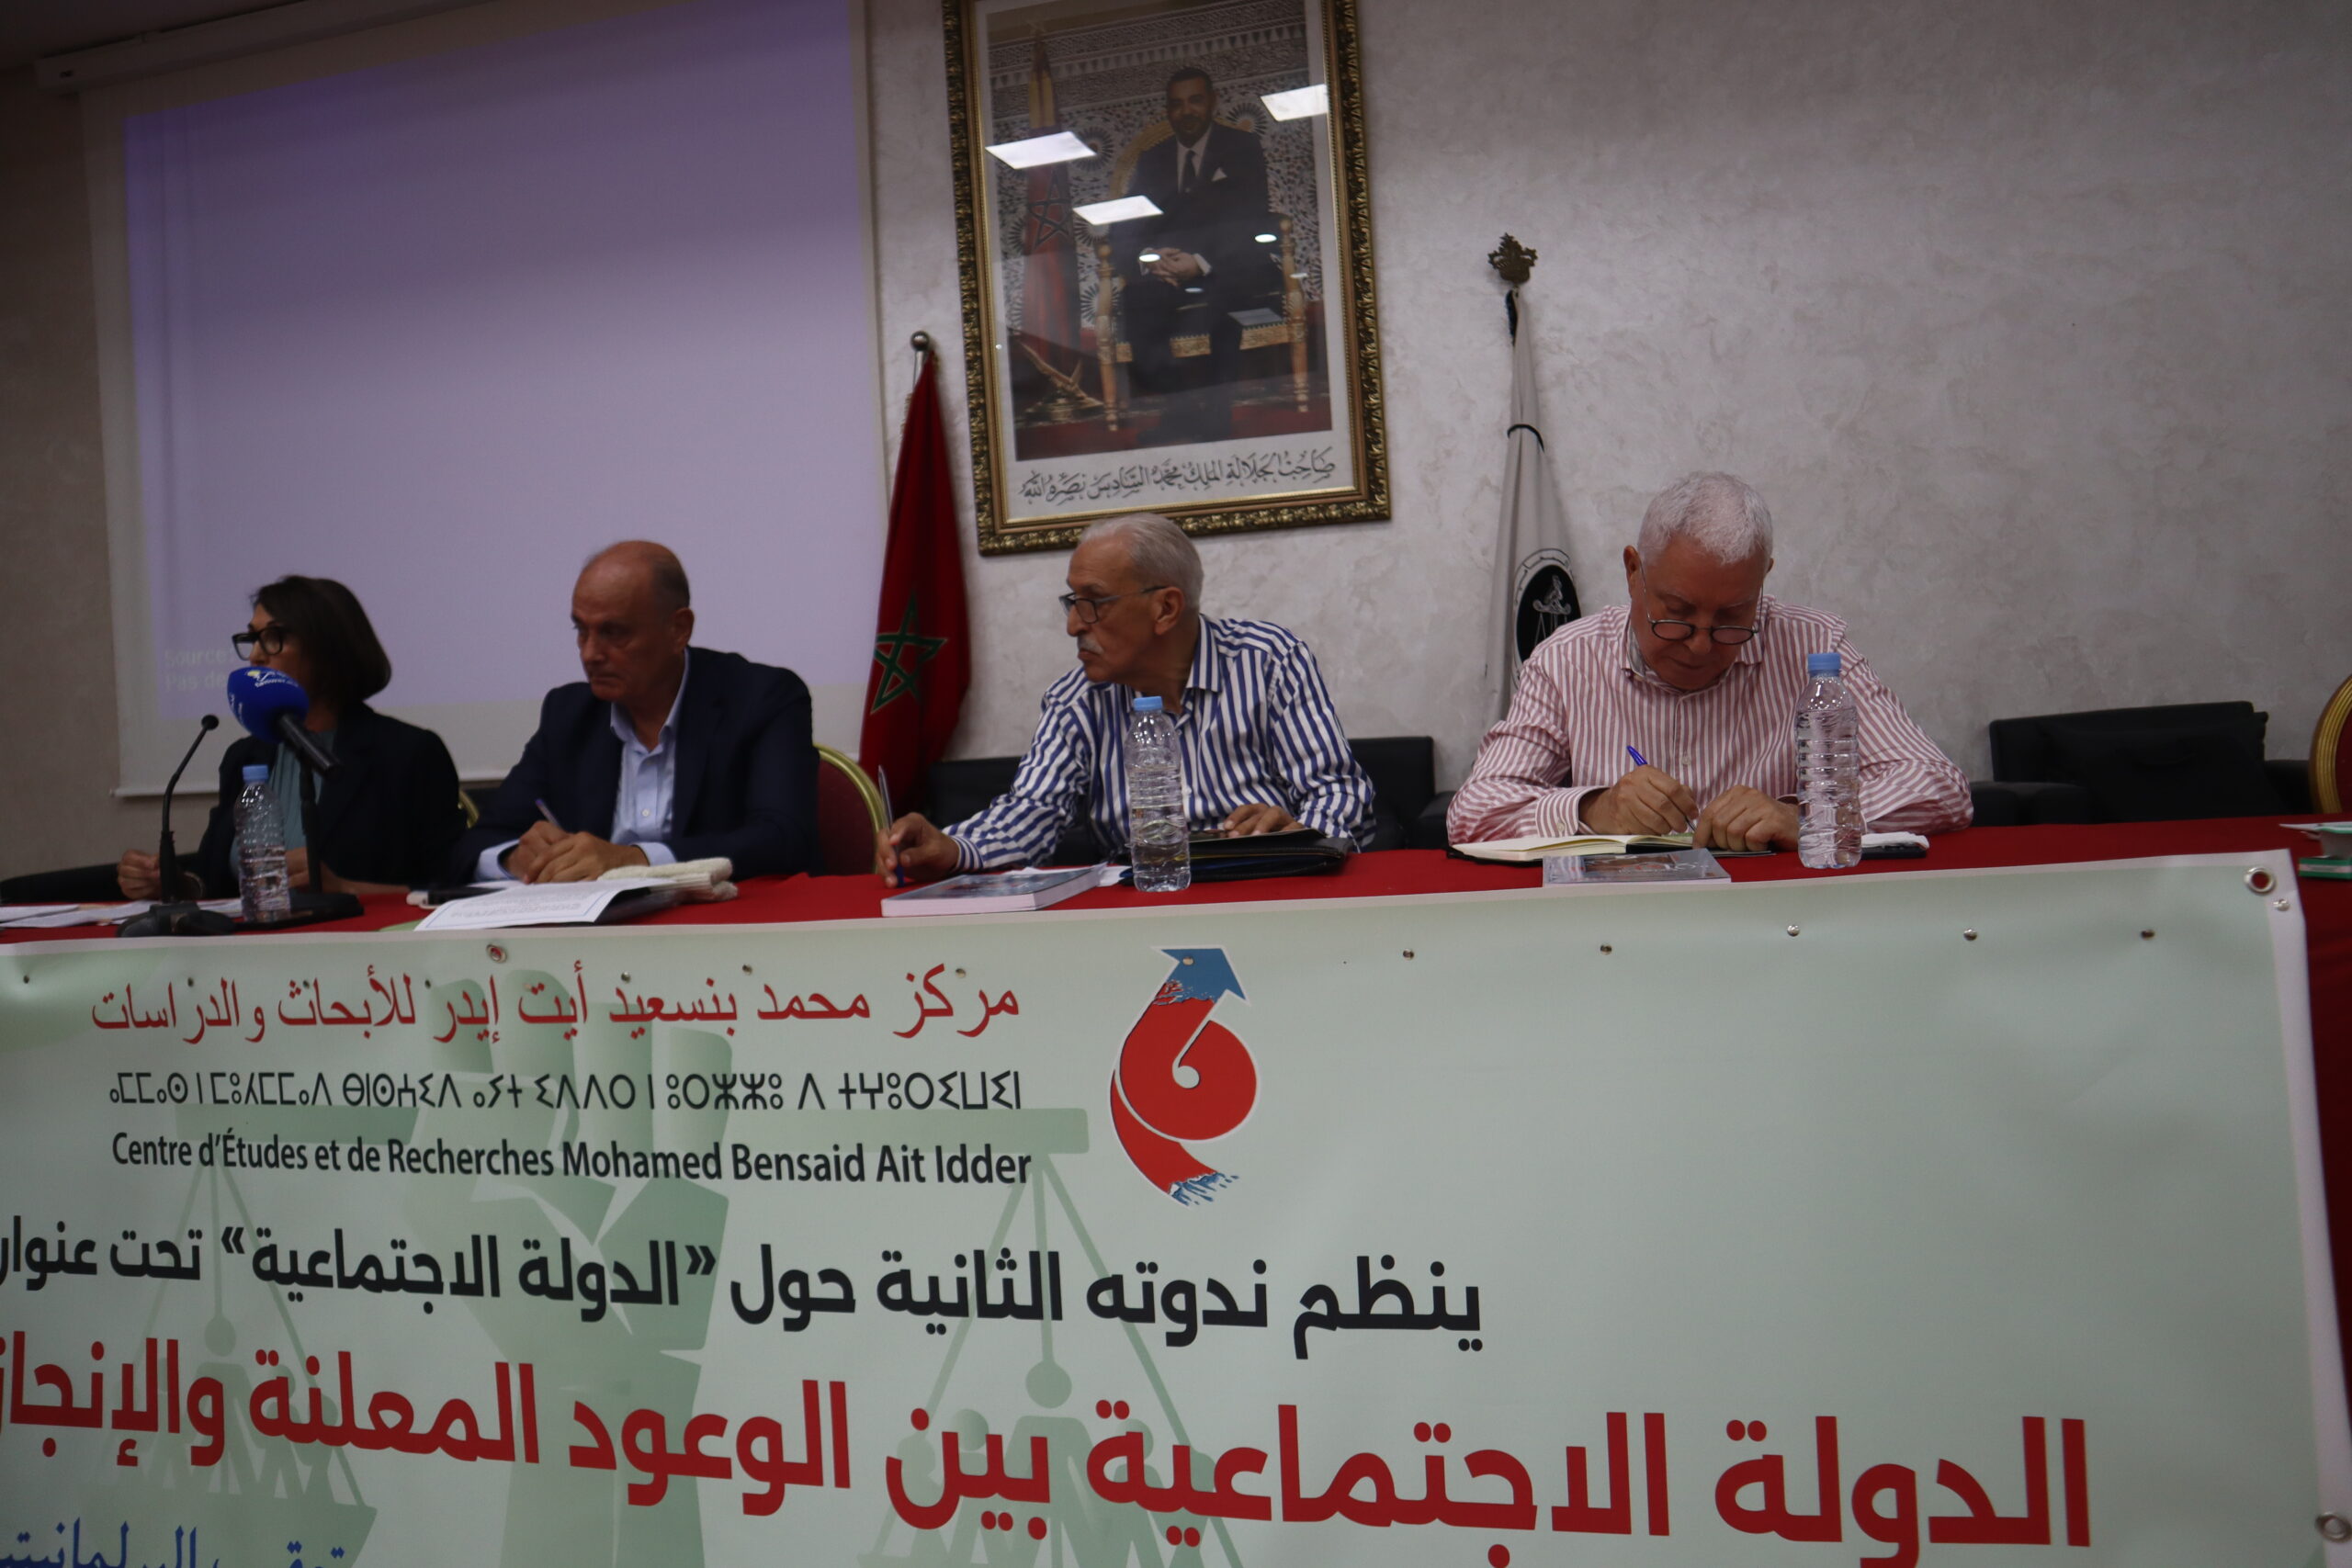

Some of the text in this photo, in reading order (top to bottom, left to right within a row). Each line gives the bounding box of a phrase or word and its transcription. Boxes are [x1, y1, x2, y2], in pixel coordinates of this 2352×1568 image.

[90, 960, 1020, 1045] مركز محمد بنسعيد أيت إيدر للأبحاث والدراسات
[111, 1132, 193, 1168] Centre
[314, 1139, 341, 1171] et
[347, 1135, 380, 1172] de
[387, 1138, 554, 1177] Recherches
[562, 1141, 722, 1180] Mohamed
[731, 1143, 865, 1182] Bensaid
[876, 1145, 926, 1183] Ait
[935, 1143, 1032, 1185] Idder
[109, 1228, 204, 1281] تحت
[729, 1243, 857, 1333] حول
[876, 1246, 1064, 1336] الثانية
[1086, 1258, 1269, 1348] ندوته
[1294, 1254, 1484, 1360] ينظم
[248, 1348, 540, 1465] المعلنة
[568, 1379, 853, 1518] الوعود
[885, 1407, 1052, 1542] بين
[1086, 1398, 1671, 1568] الاجتماعية
[1714, 1414, 2091, 1568] الدولة
